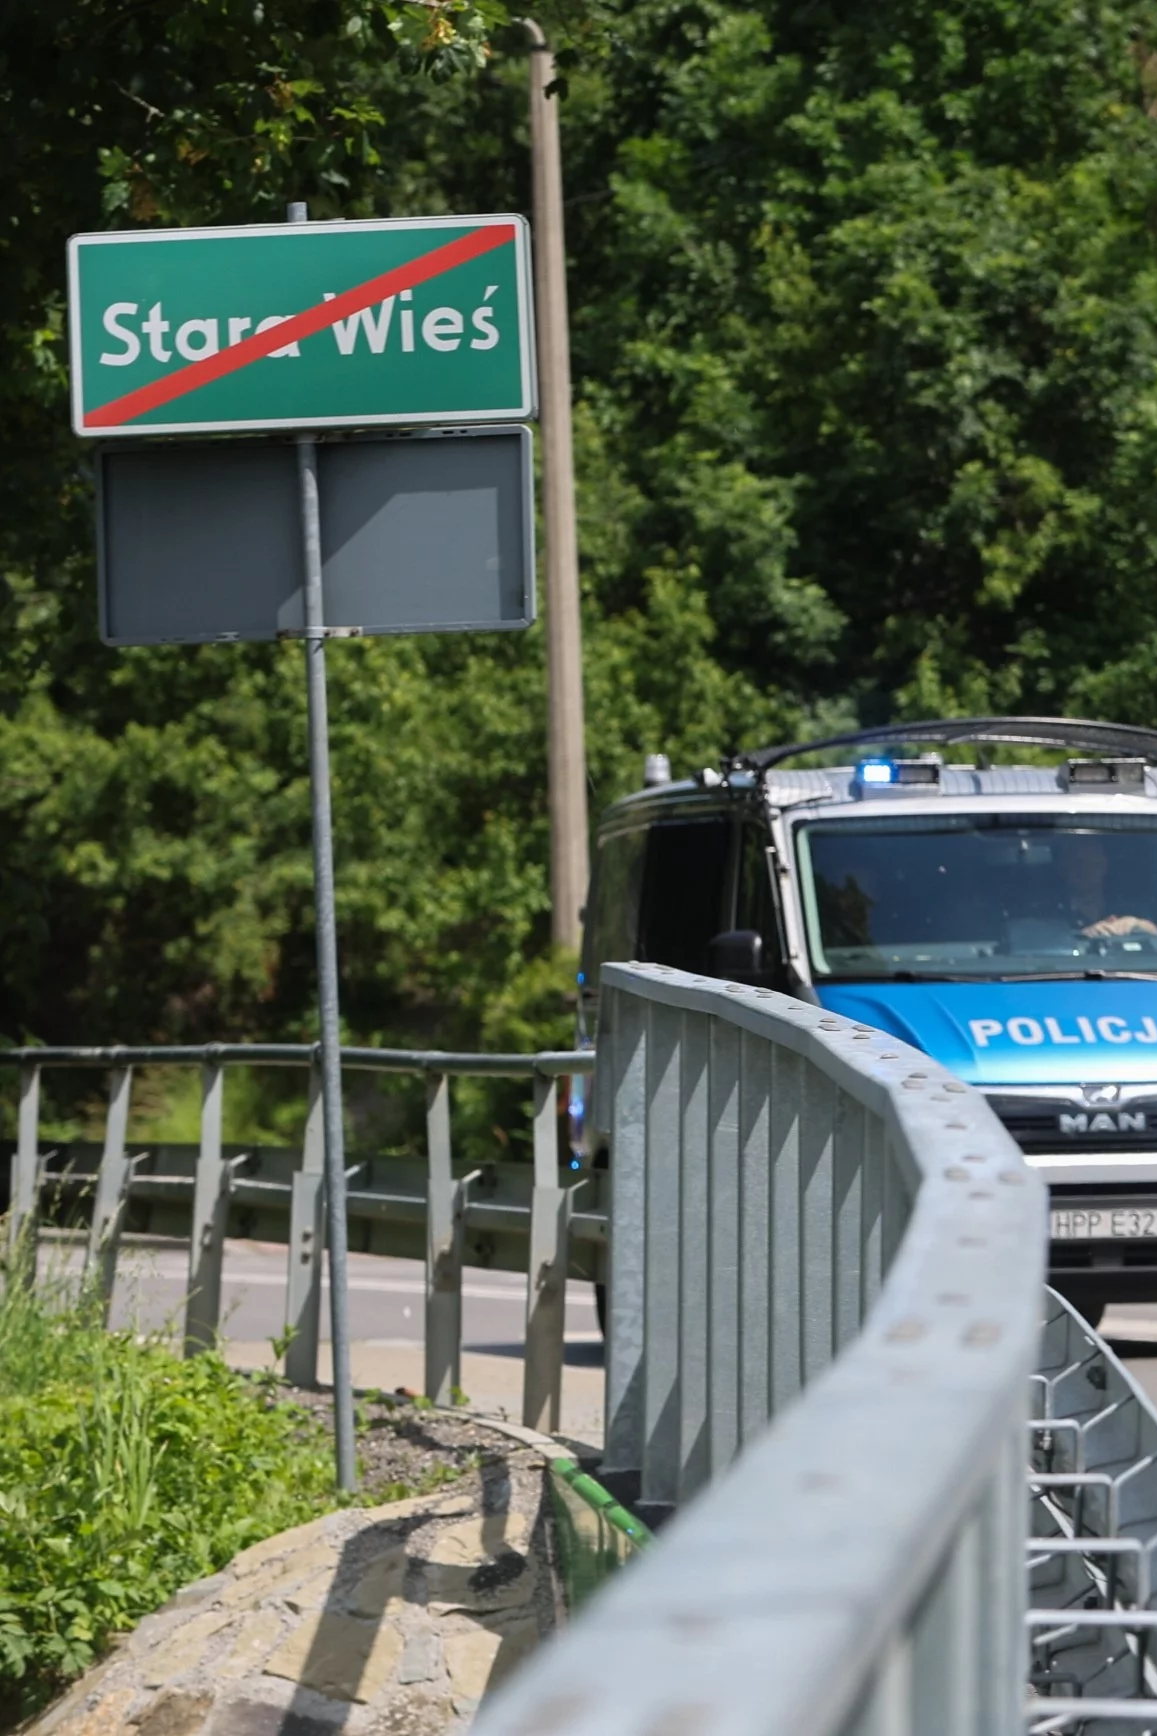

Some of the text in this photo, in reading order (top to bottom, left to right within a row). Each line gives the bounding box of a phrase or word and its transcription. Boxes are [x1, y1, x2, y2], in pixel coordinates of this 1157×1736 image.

[323, 285, 501, 355] Wieś
[1058, 1112, 1147, 1132] MAN
[1056, 1211, 1100, 1239] HPP
